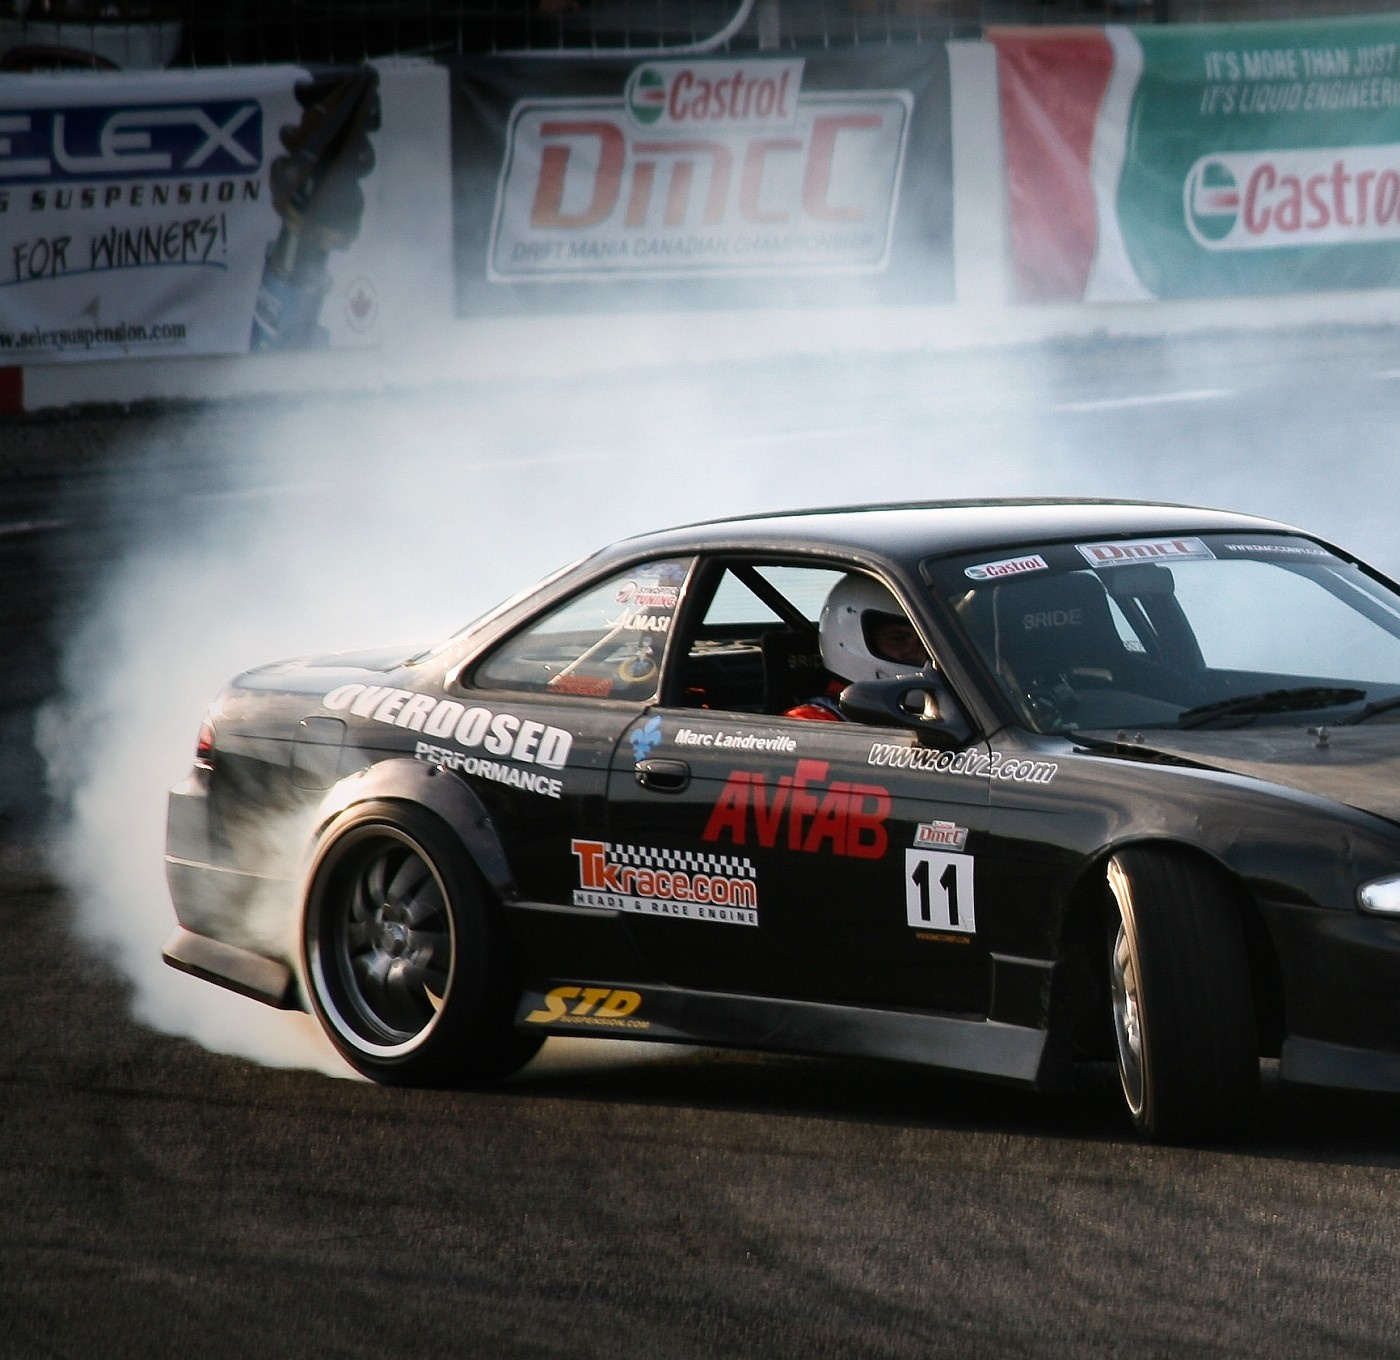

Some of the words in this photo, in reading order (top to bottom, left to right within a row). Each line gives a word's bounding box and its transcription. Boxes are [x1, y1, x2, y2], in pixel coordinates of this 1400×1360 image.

[1205, 51, 1240, 80] IT'S
[1243, 49, 1298, 79] MORE
[1302, 48, 1349, 77] THAN
[1354, 43, 1395, 75] JUST
[669, 68, 790, 120] Castrol
[1238, 82, 1300, 113] LIQUID
[31, 178, 260, 212] SUSPENSION
[13, 234, 71, 281] FOR
[90, 211, 228, 270] WINNERS!
[511, 240, 567, 262] DRIFT
[986, 559, 1043, 577] Castrol
[1023, 608, 1082, 630] BRIDE
[323, 685, 572, 770] OVERDOSED
[674, 728, 713, 748] Marc
[713, 732, 797, 752] Landreville
[416, 742, 564, 799] PERFORMANCE
[867, 743, 1059, 784] www.odv2.com
[703, 759, 892, 859] AVFAB
[572, 839, 757, 908] Tkrace.com
[576, 893, 624, 908] HEADS
[634, 900, 642, 910] &
[651, 903, 688, 916] RACE
[698, 907, 756, 923] ENGINE
[911, 860, 959, 926] 11
[524, 986, 642, 1024] STD
